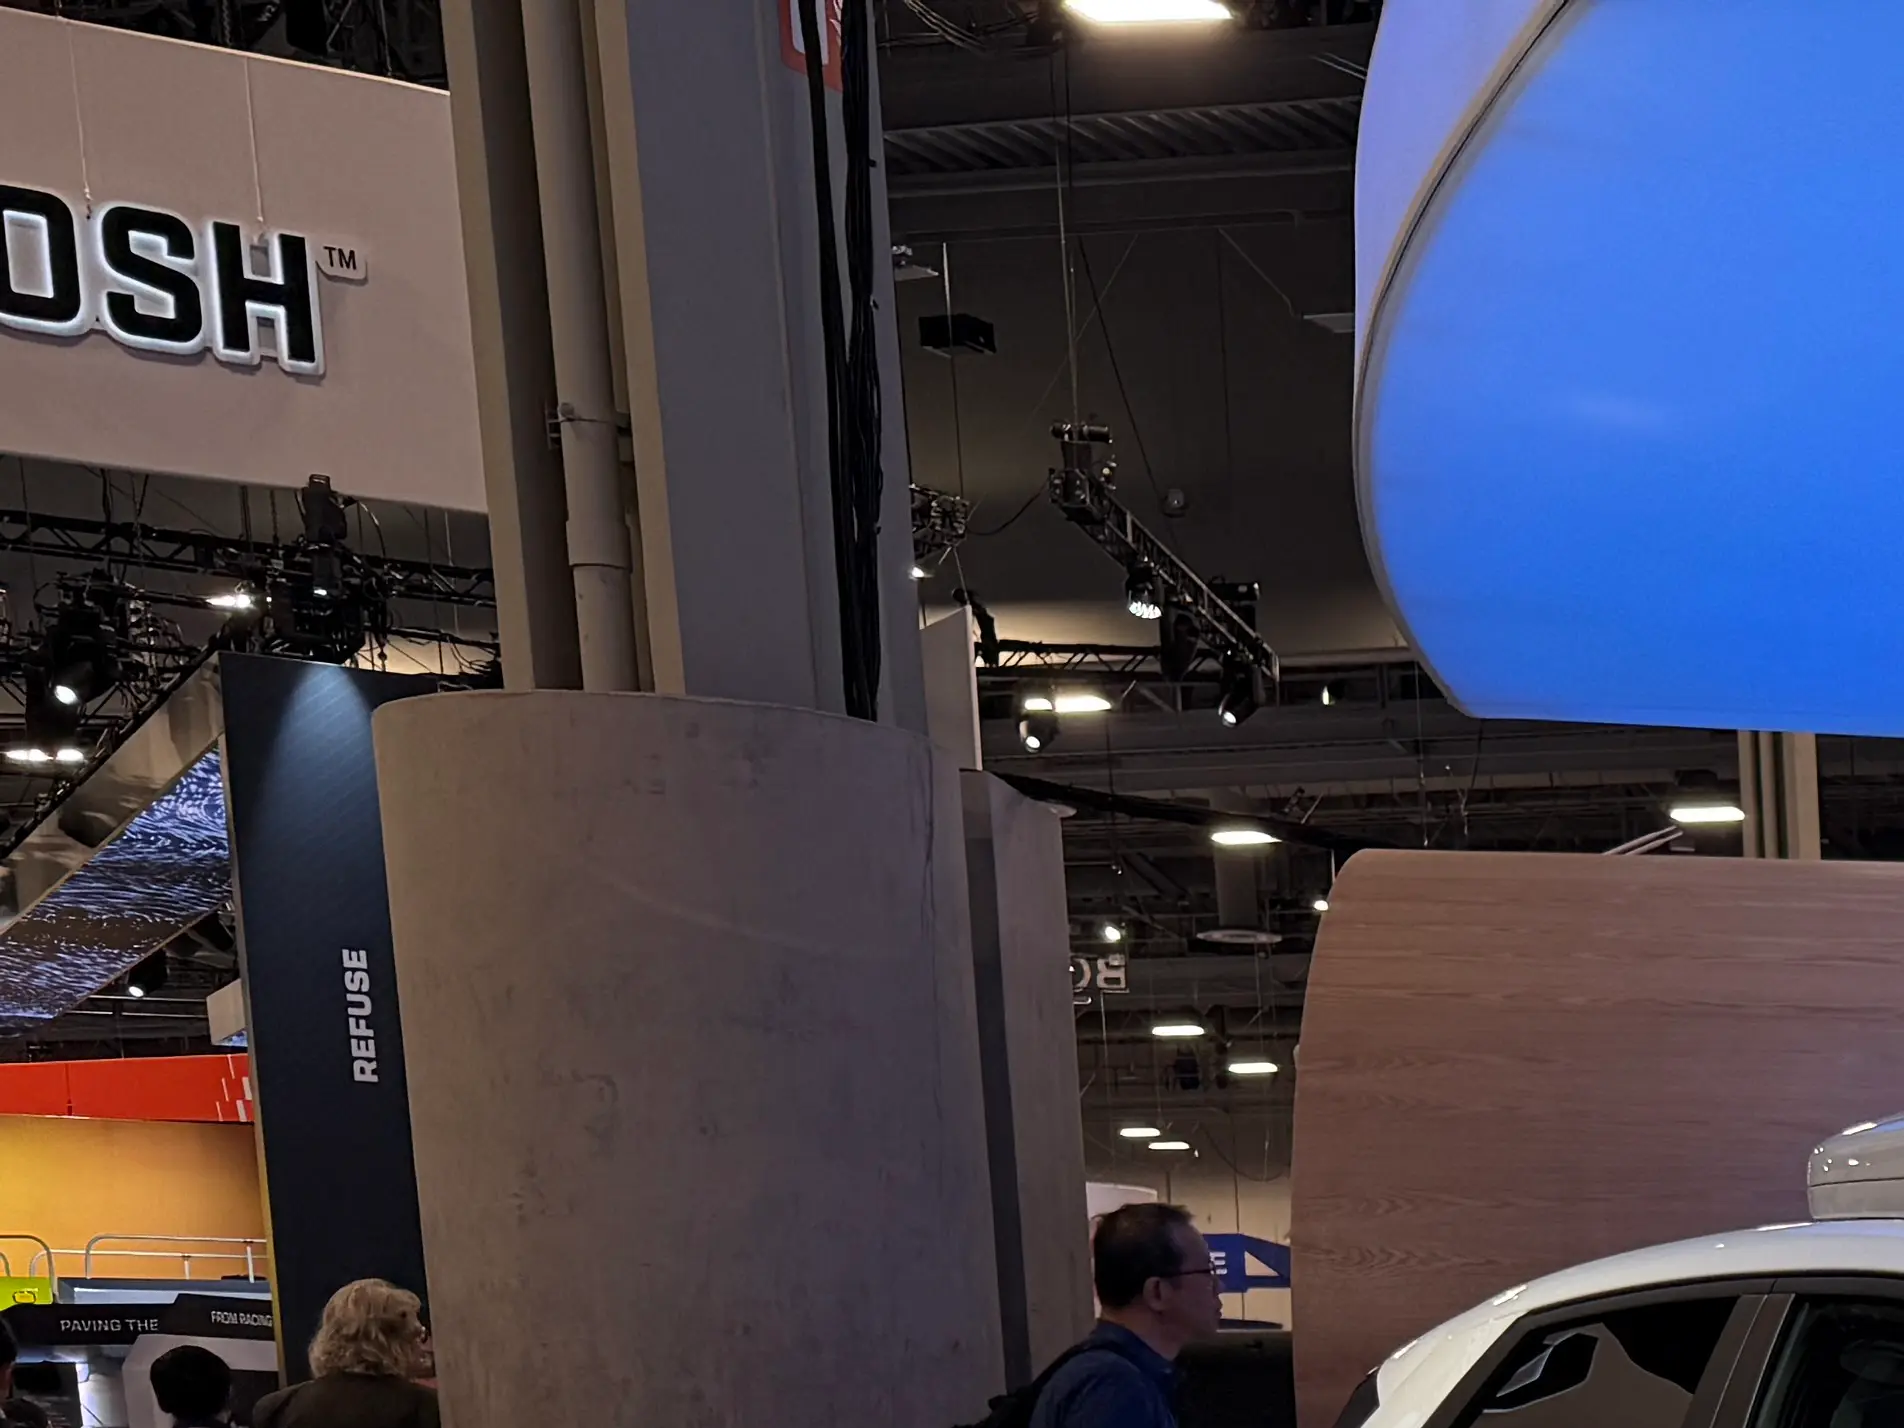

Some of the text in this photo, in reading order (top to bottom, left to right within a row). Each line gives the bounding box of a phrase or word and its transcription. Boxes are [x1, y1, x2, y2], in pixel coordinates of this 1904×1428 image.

[342, 948, 379, 1083] REFUSE
[60, 1318, 159, 1332] PAVING THE
[211, 1311, 238, 1325] FROM
